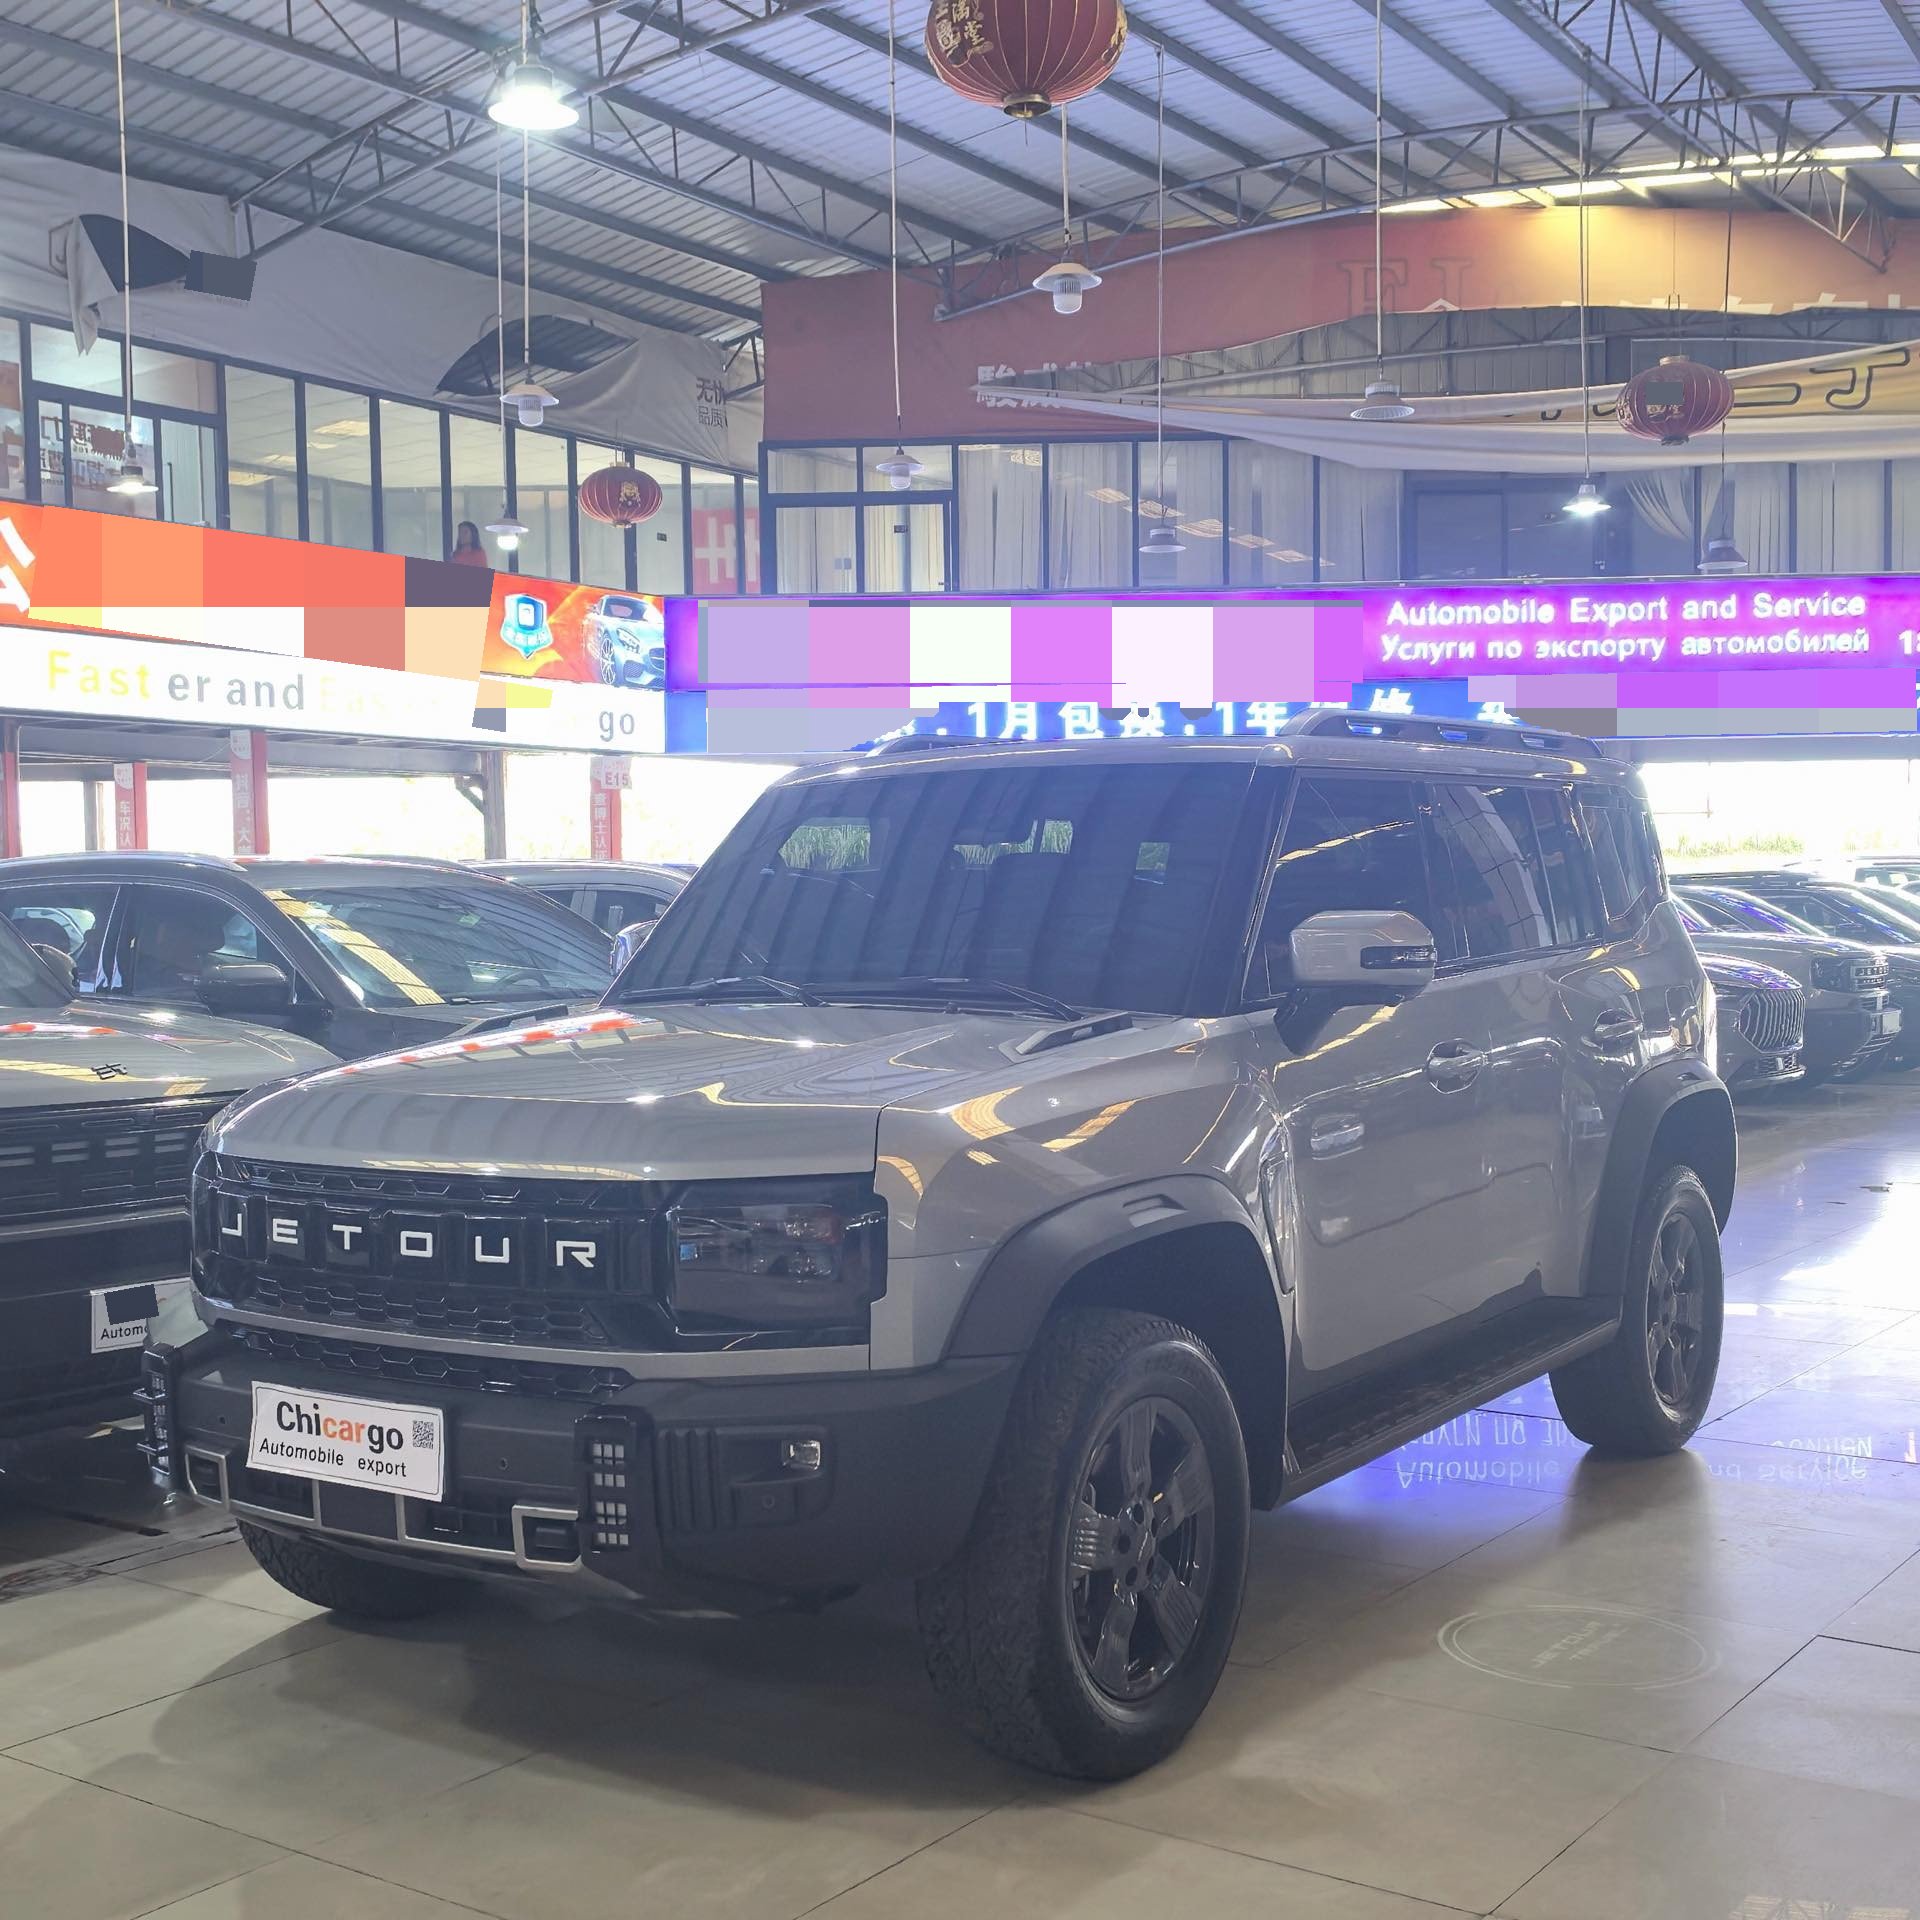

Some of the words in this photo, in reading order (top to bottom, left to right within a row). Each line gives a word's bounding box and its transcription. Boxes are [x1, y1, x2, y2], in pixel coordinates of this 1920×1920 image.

[1387, 600, 1555, 626] Automobile
[1570, 597, 1668, 628] Export
[1682, 593, 1737, 620] and
[1752, 592, 1866, 619] Service
[1381, 634, 1475, 665] Услуги
[1488, 640, 1522, 660] по
[1535, 636, 1666, 662] экспорту
[1681, 627, 1870, 656] автомобилей
[226, 673, 305, 711] and
[605, 772, 629, 787] E15
[221, 1212, 597, 1268] JETOUR
[276, 1401, 404, 1454] Chicargo
[259, 1437, 344, 1466] Automobile
[358, 1456, 407, 1477] export
